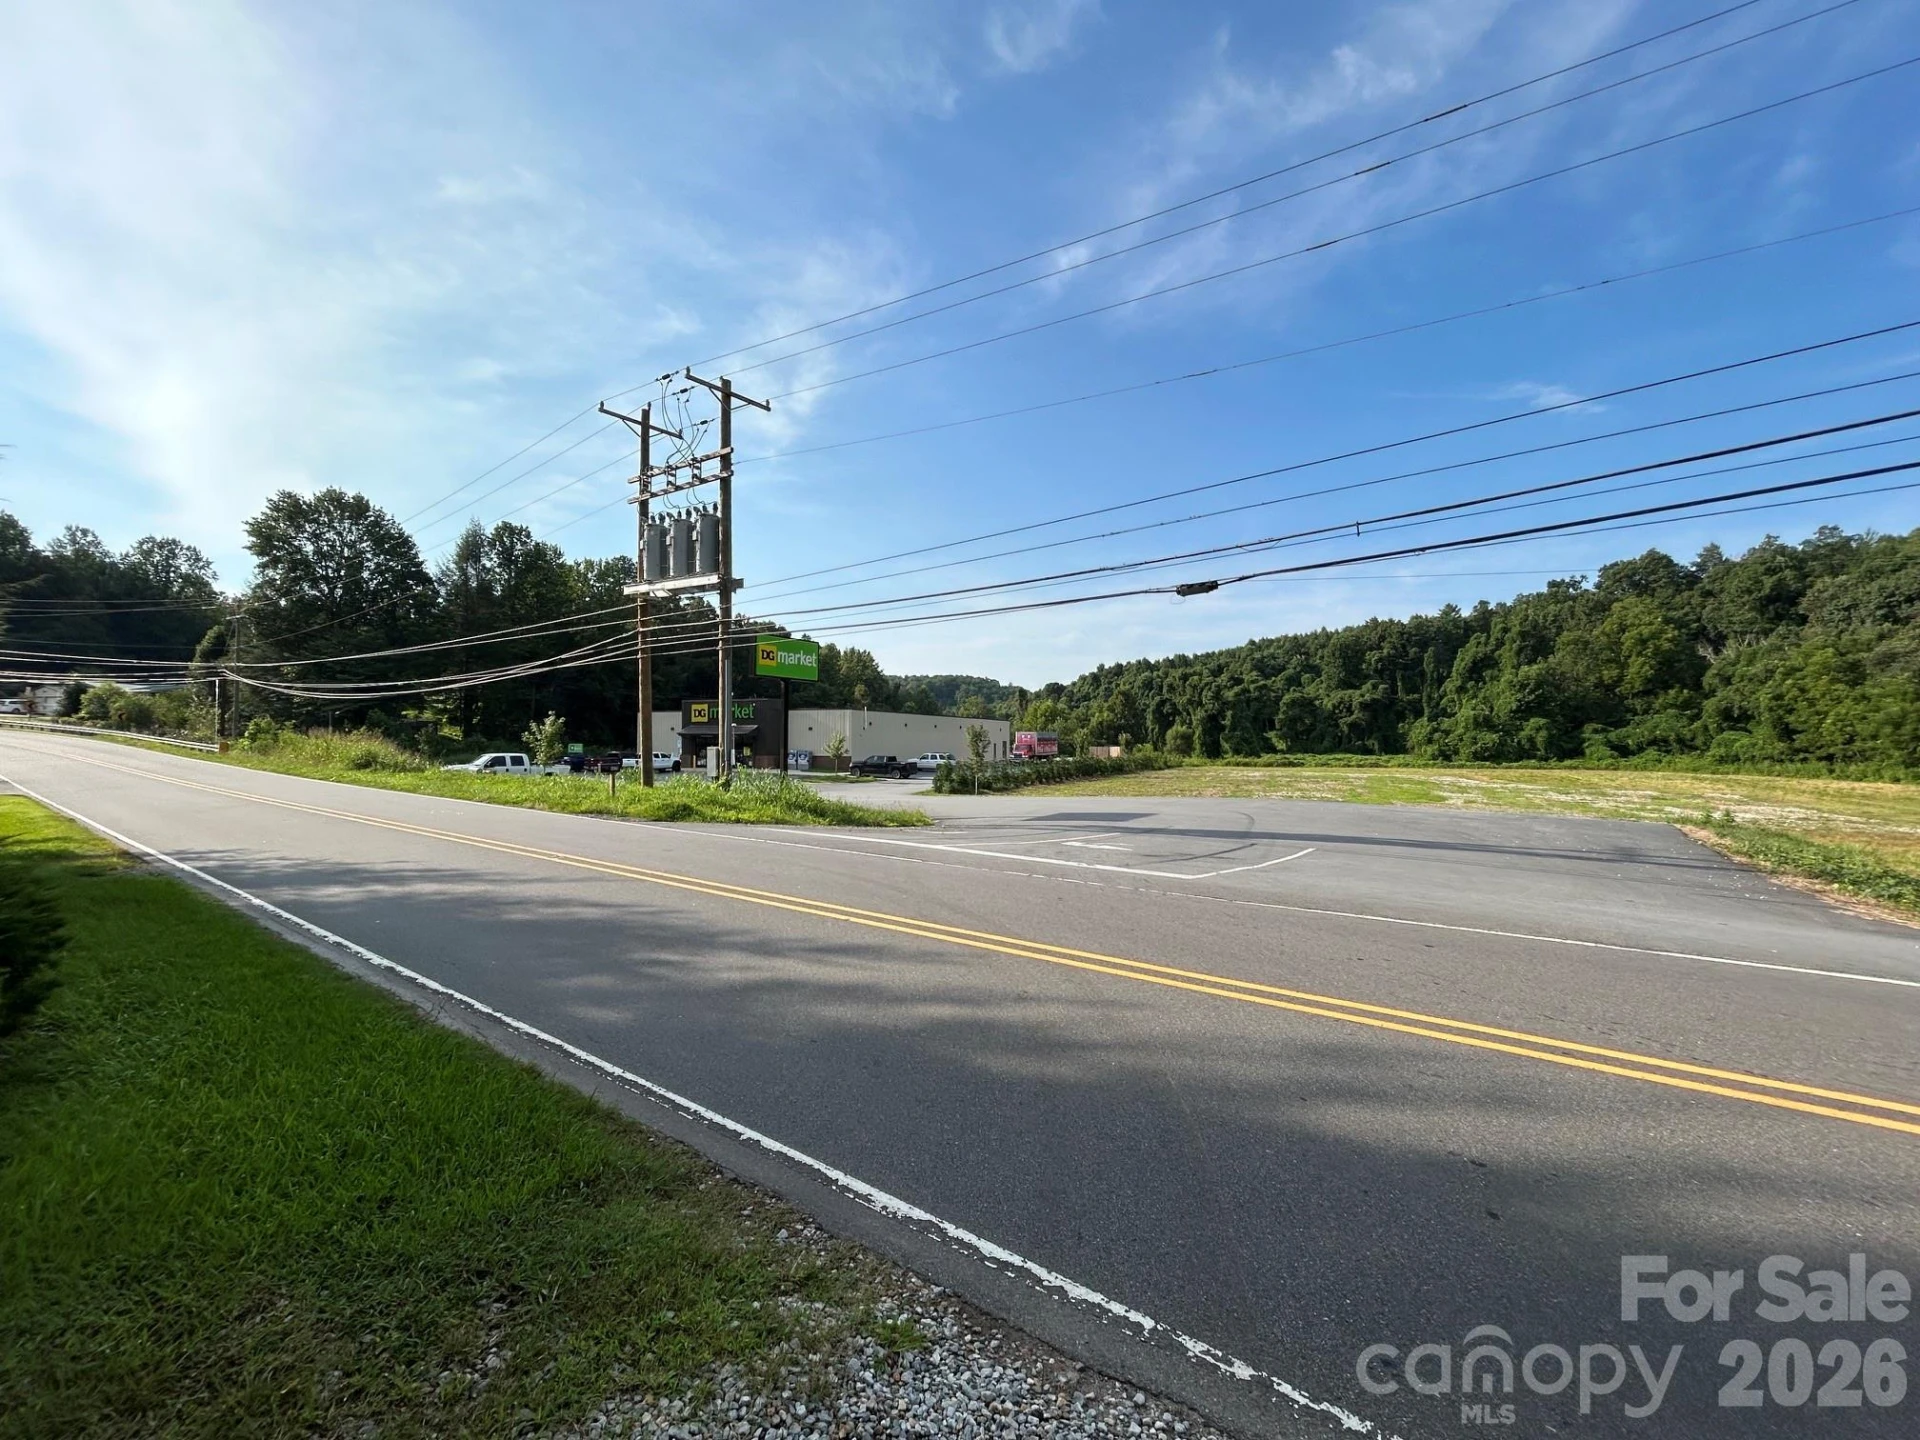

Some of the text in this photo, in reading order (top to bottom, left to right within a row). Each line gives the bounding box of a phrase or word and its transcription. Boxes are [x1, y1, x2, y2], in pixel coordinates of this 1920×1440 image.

[761, 649, 817, 667] DG market
[693, 704, 755, 719] DG mket
